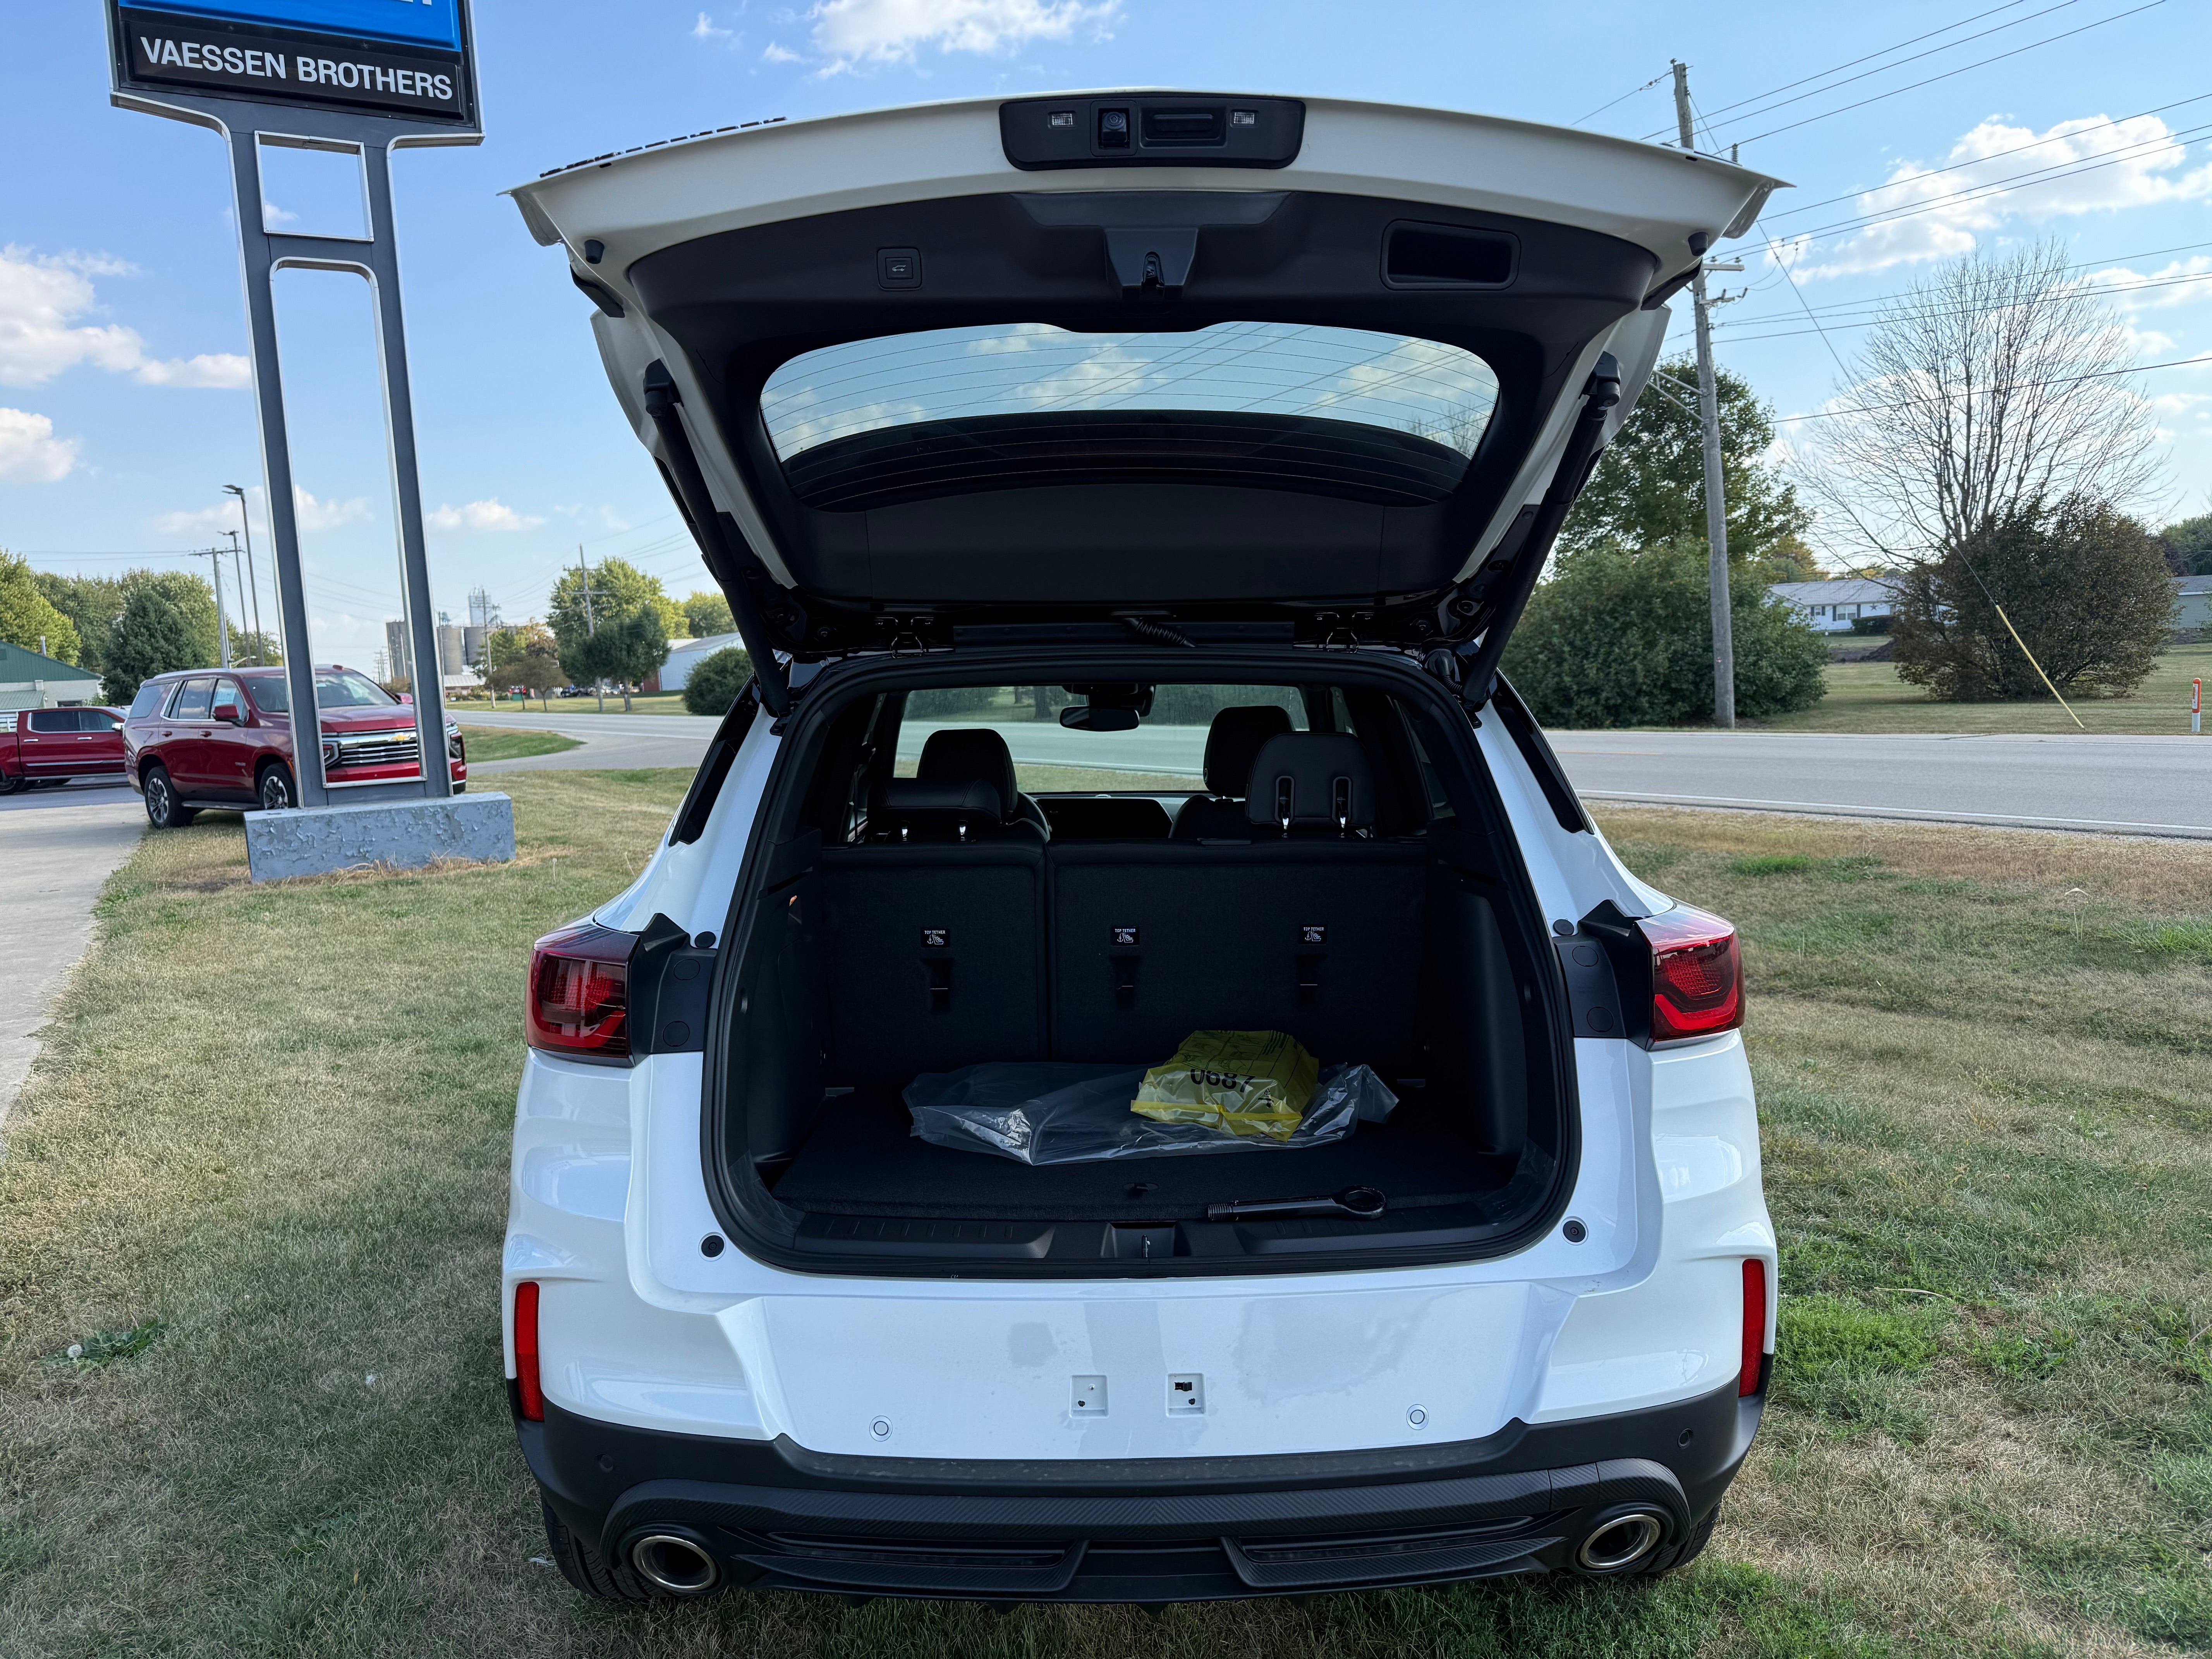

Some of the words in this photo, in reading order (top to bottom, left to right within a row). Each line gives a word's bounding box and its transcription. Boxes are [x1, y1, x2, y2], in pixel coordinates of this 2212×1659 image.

[140, 36, 287, 79] VAESSEN
[297, 56, 452, 100] BROTHERS
[1190, 1068, 1256, 1093] 0687
